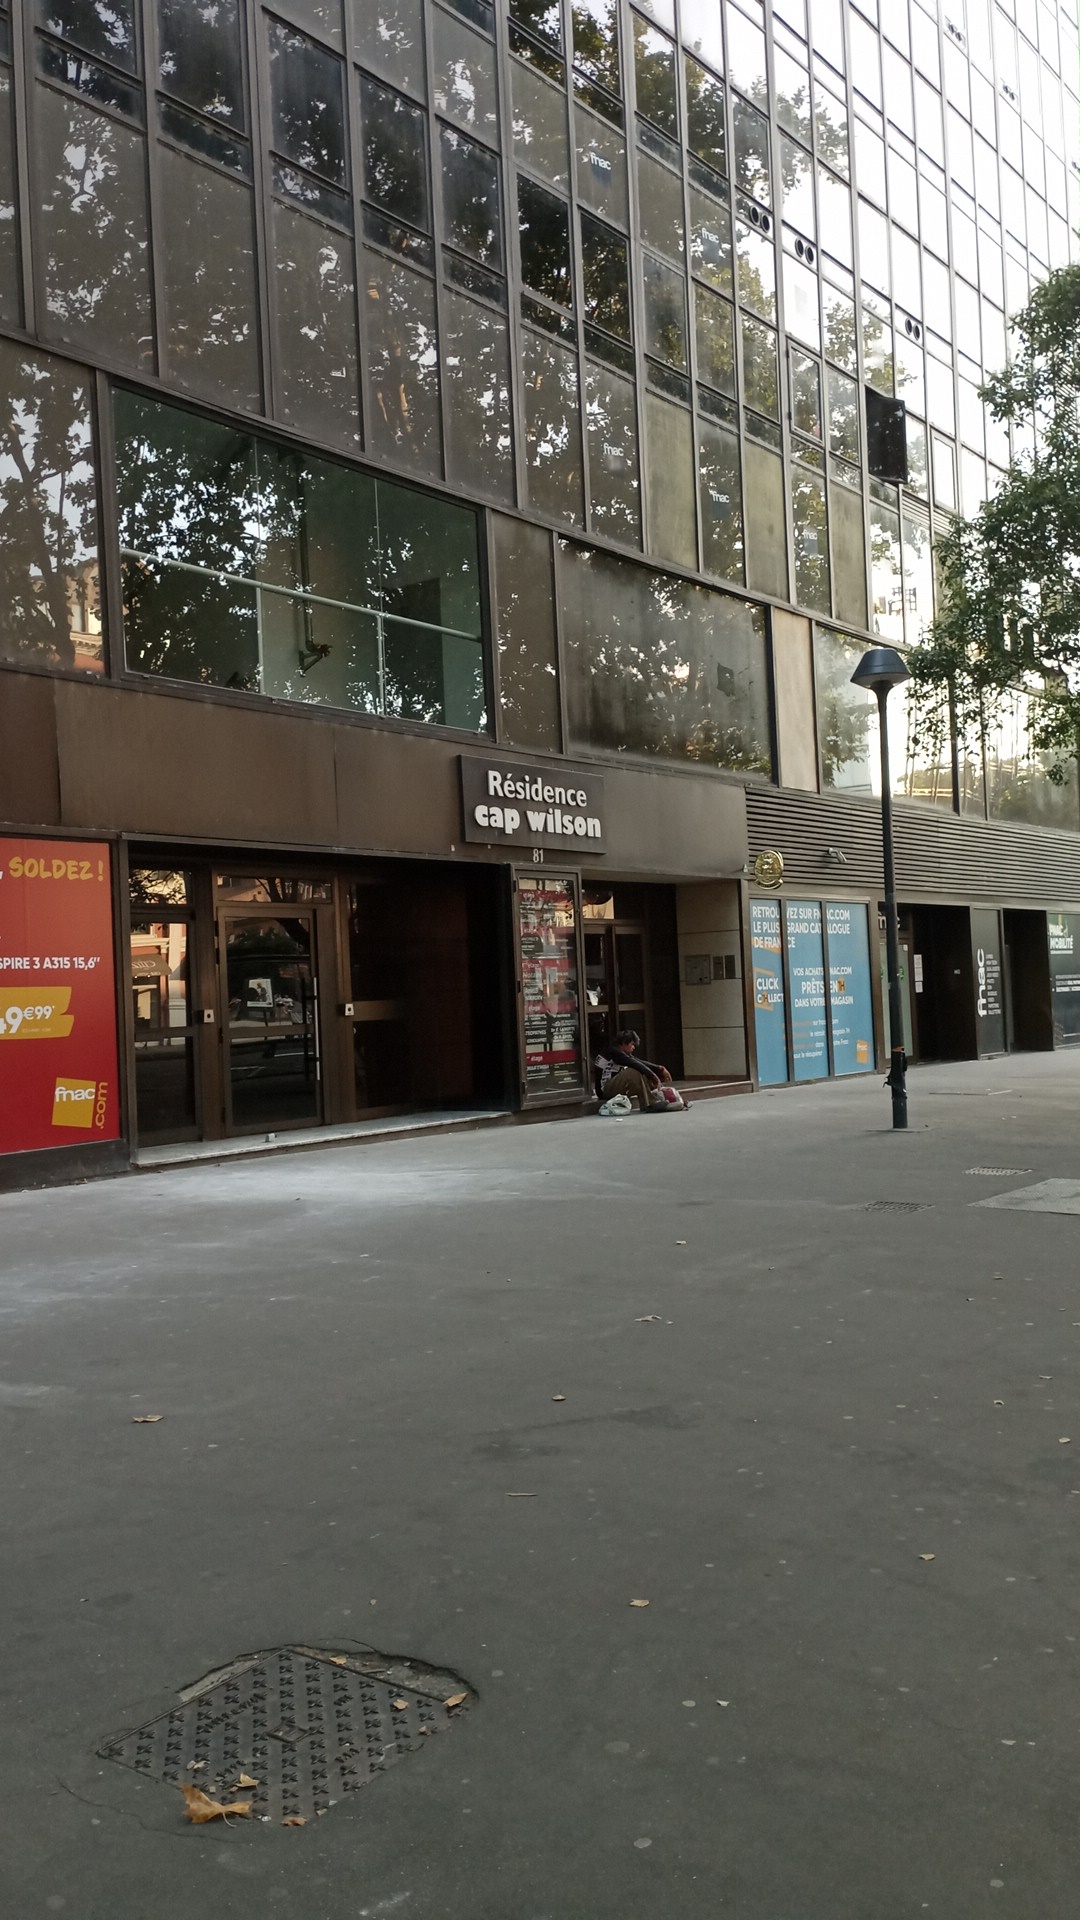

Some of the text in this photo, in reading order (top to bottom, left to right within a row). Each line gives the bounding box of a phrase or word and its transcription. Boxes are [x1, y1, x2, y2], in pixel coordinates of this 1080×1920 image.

[590, 152, 611, 170] fnac
[702, 228, 720, 243] fnac
[603, 443, 624, 457] fnac
[712, 492, 730, 503] fnac
[803, 530, 818, 540] fnac
[487, 770, 587, 807] Résidence
[474, 804, 602, 838] cap wilson
[532, 848, 544, 863] 81
[9, 856, 104, 882] SOLDEZ !
[800, 908, 813, 920] SUR
[753, 921, 762, 933] LE
[763, 922, 781, 934] PLUS
[787, 923, 810, 935] GRAND
[754, 936, 764, 948] DE
[1049, 935, 1074, 950] MOBILITÉ
[32, 956, 41, 970] 3
[43, 956, 71, 970] A315
[793, 967, 804, 976] VOS
[805, 967, 824, 976] ACHATS
[756, 977, 780, 991] CLICK
[801, 978, 825, 995] PRÊTS
[977, 948, 988, 1018] fnac
[794, 996, 854, 1008] DANS VOTRE MAGASIN
[54, 1086, 96, 1103] fnac
[95, 1081, 109, 1130] .com
